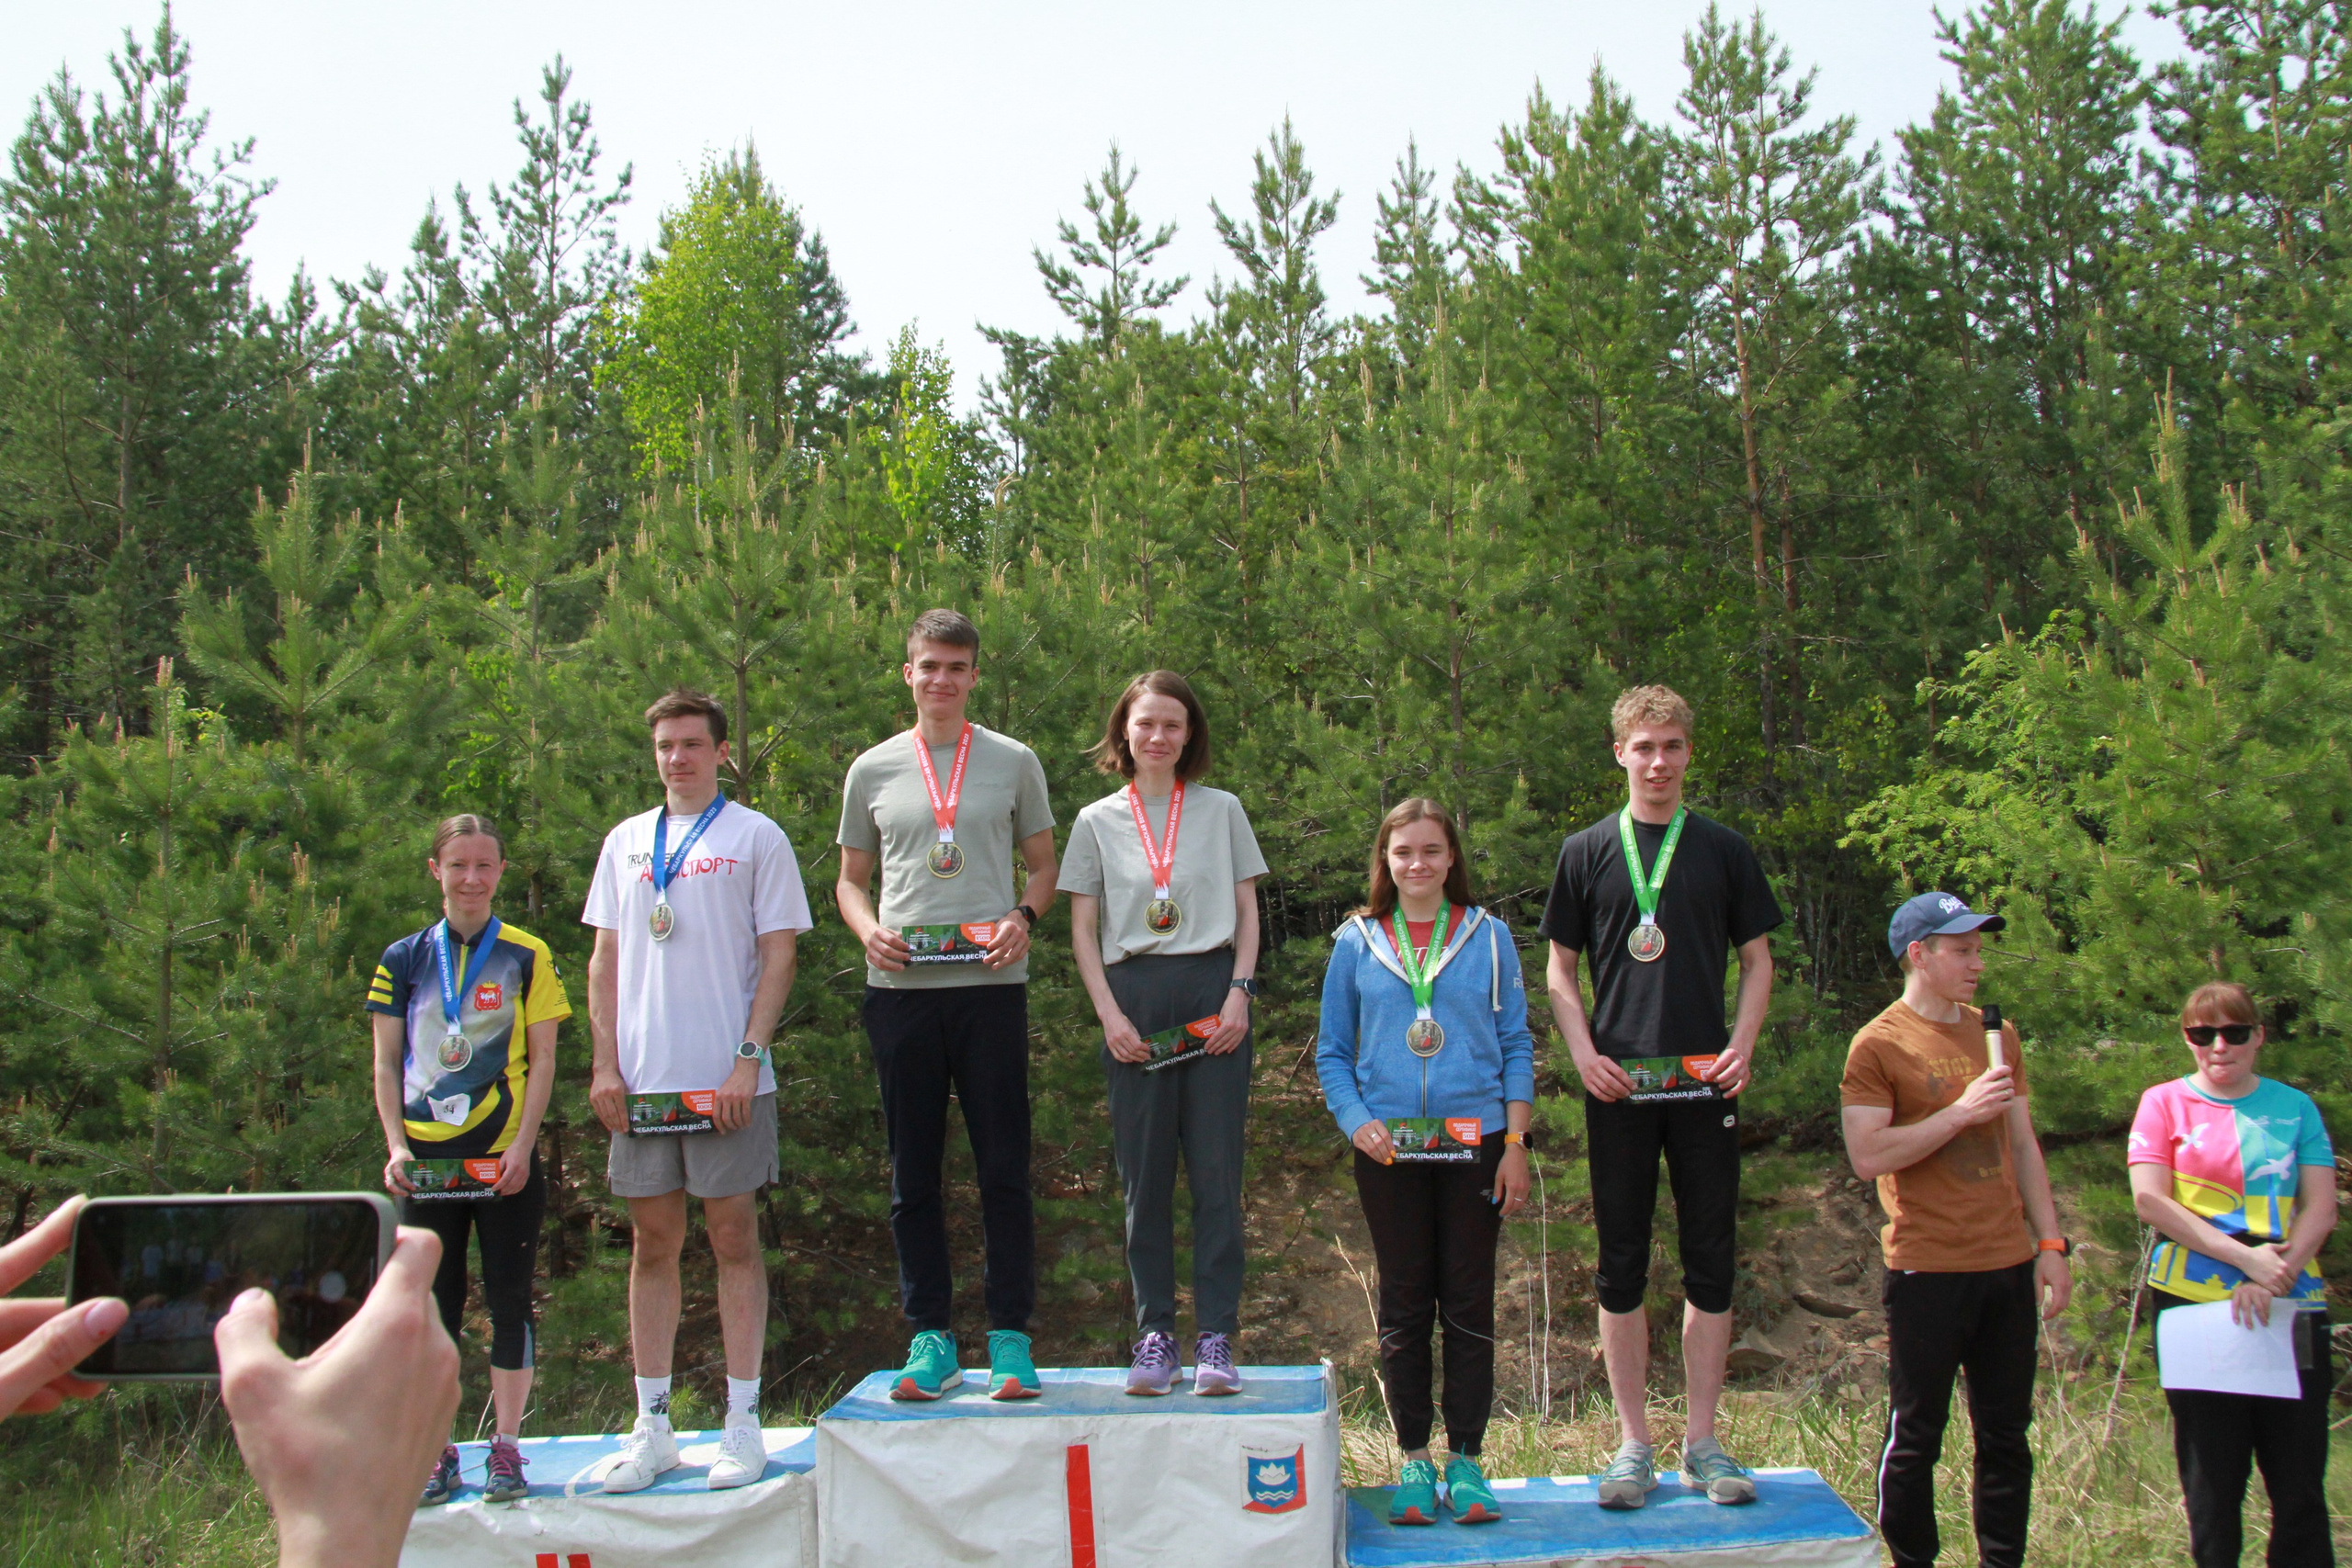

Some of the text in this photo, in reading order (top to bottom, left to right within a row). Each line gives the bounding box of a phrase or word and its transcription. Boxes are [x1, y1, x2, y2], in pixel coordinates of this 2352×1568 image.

[1146, 1050, 1199, 1071] ЧЕБАРКУЛЬСКАЯ
[1629, 1091, 1688, 1100] ЧЕБАРКУЛЬСКАЯ
[412, 1191, 470, 1200] ЧЕБАРКУЛЬСКАЯ
